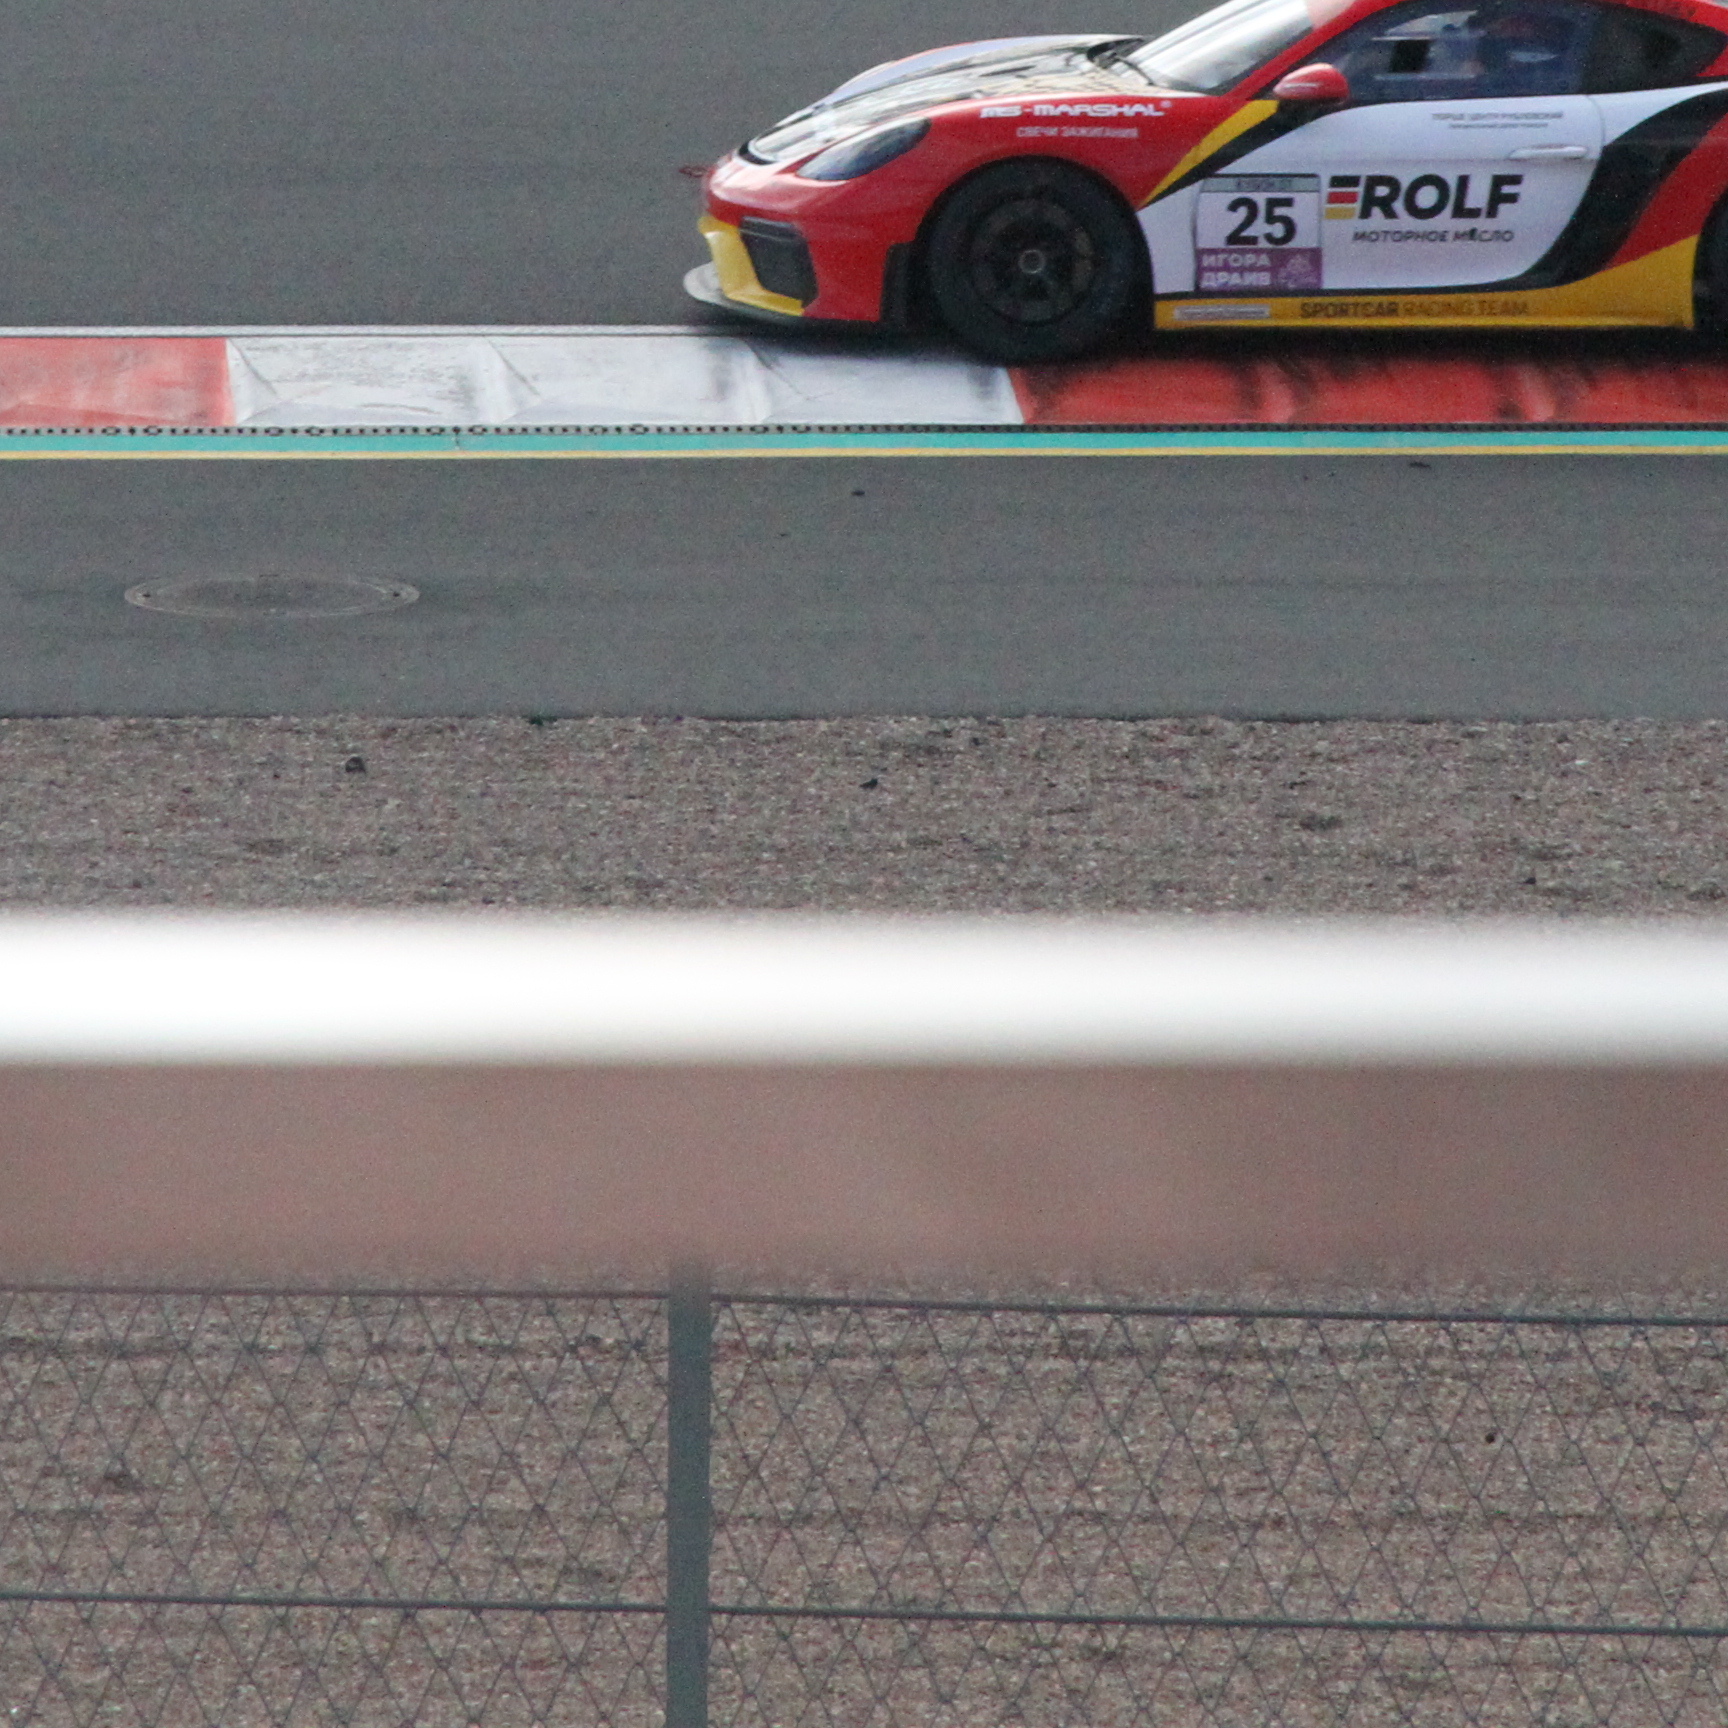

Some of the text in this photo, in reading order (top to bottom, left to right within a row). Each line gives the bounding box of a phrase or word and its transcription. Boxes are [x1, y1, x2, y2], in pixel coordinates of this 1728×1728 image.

[1358, 174, 1524, 220] ROLF
[1225, 197, 1297, 246] 25
[1201, 253, 1272, 268] ИГОРА
[1300, 301, 1400, 319] SPORTCAR
